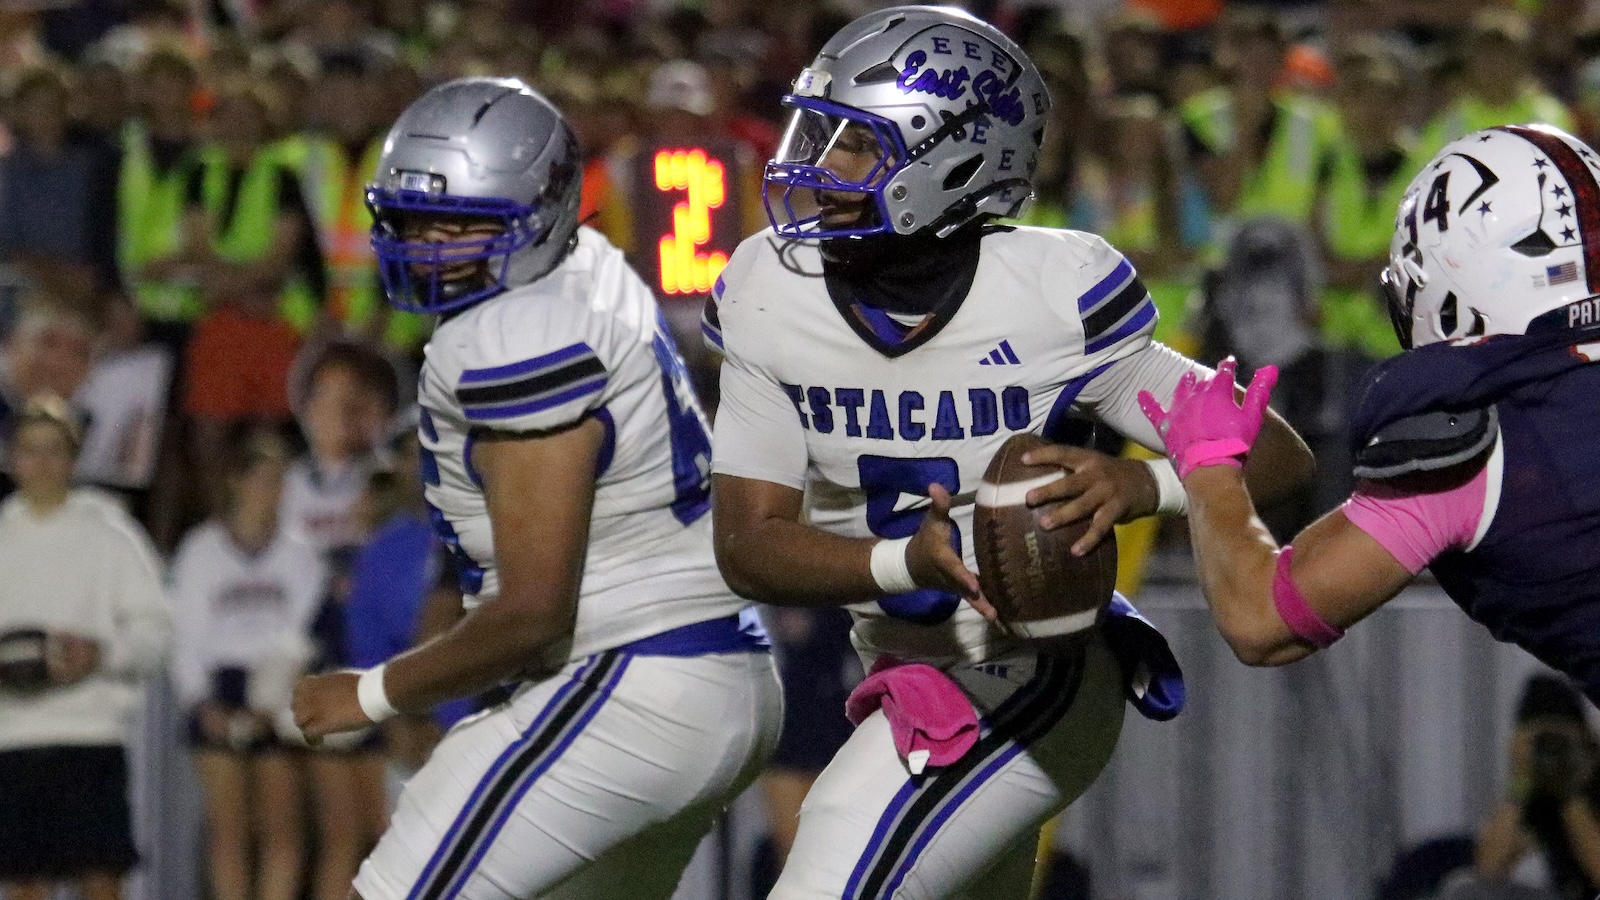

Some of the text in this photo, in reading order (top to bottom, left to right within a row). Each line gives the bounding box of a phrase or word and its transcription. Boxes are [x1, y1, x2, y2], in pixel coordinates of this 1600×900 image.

[931, 37, 1008, 74] E E E
[998, 149, 1016, 171] E
[655, 147, 729, 295] 2
[779, 380, 1032, 441] ESTACADO
[857, 454, 962, 624] 5
